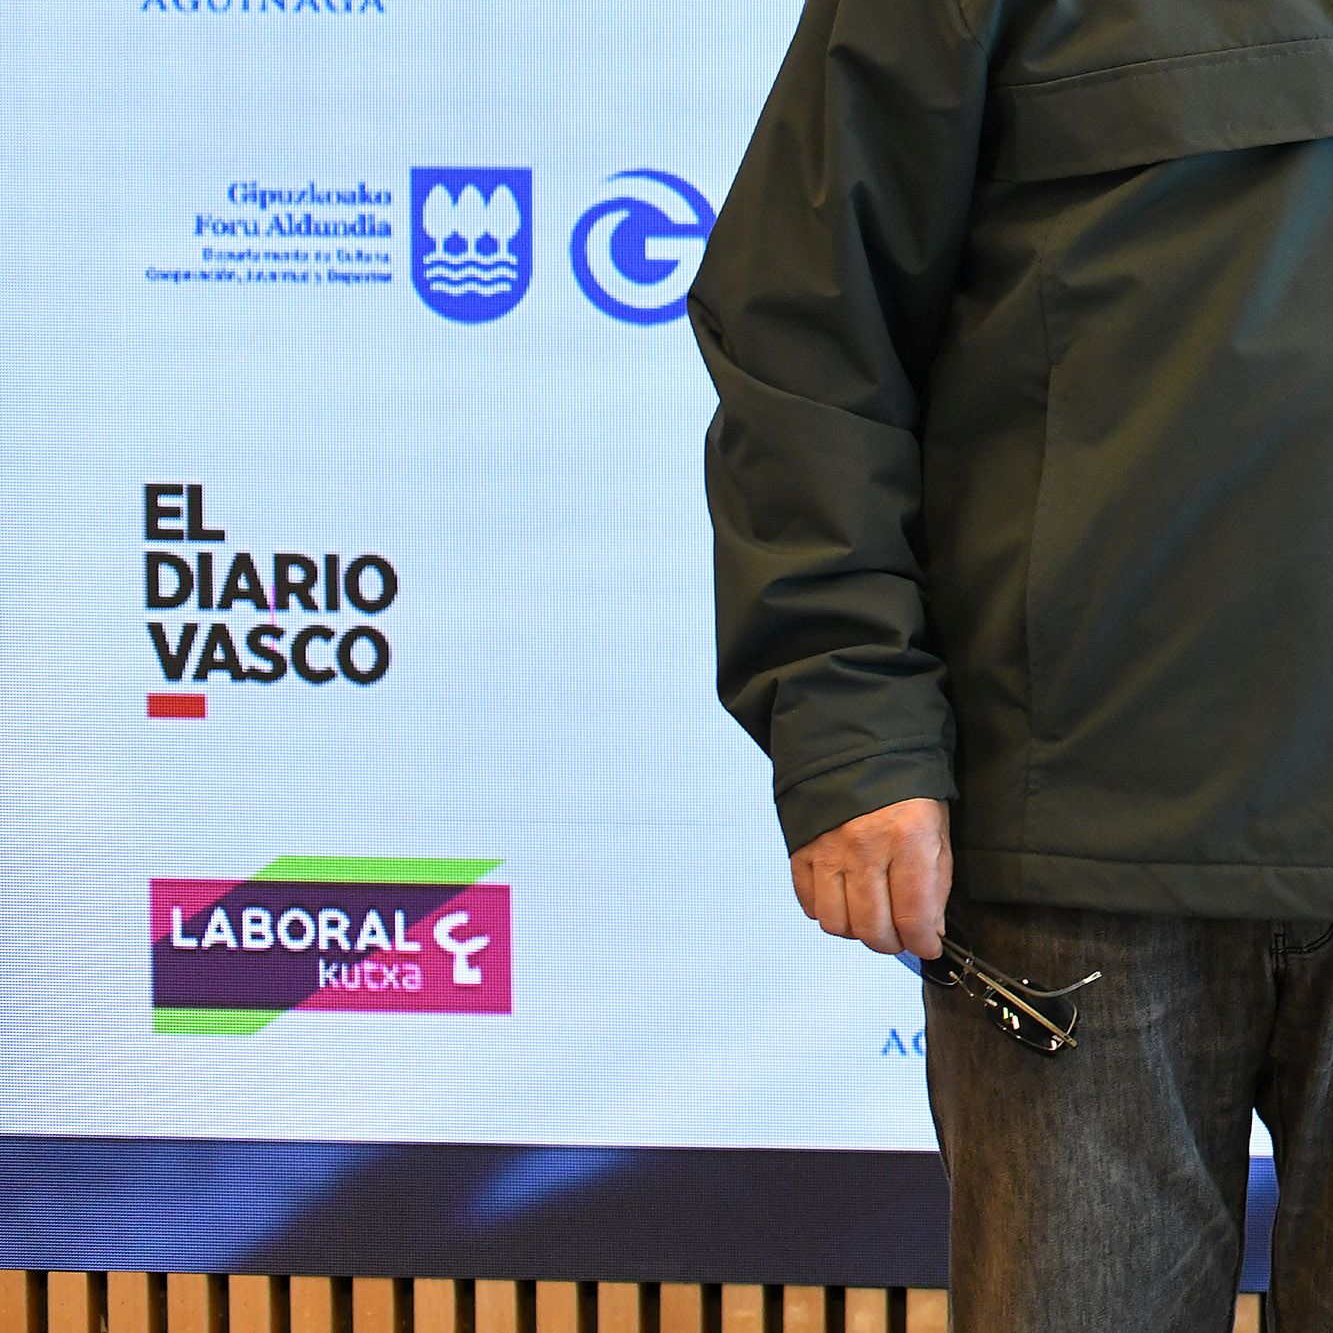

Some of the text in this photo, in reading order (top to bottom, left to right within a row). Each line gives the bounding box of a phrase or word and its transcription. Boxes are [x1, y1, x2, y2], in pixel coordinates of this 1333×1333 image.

[194, 213, 392, 238] Foru Aldundia
[143, 484, 225, 543] EL
[144, 552, 398, 613] DIARIO
[145, 622, 393, 687] VASCO
[172, 907, 421, 952] LABORAL
[319, 959, 421, 990] kutxa
